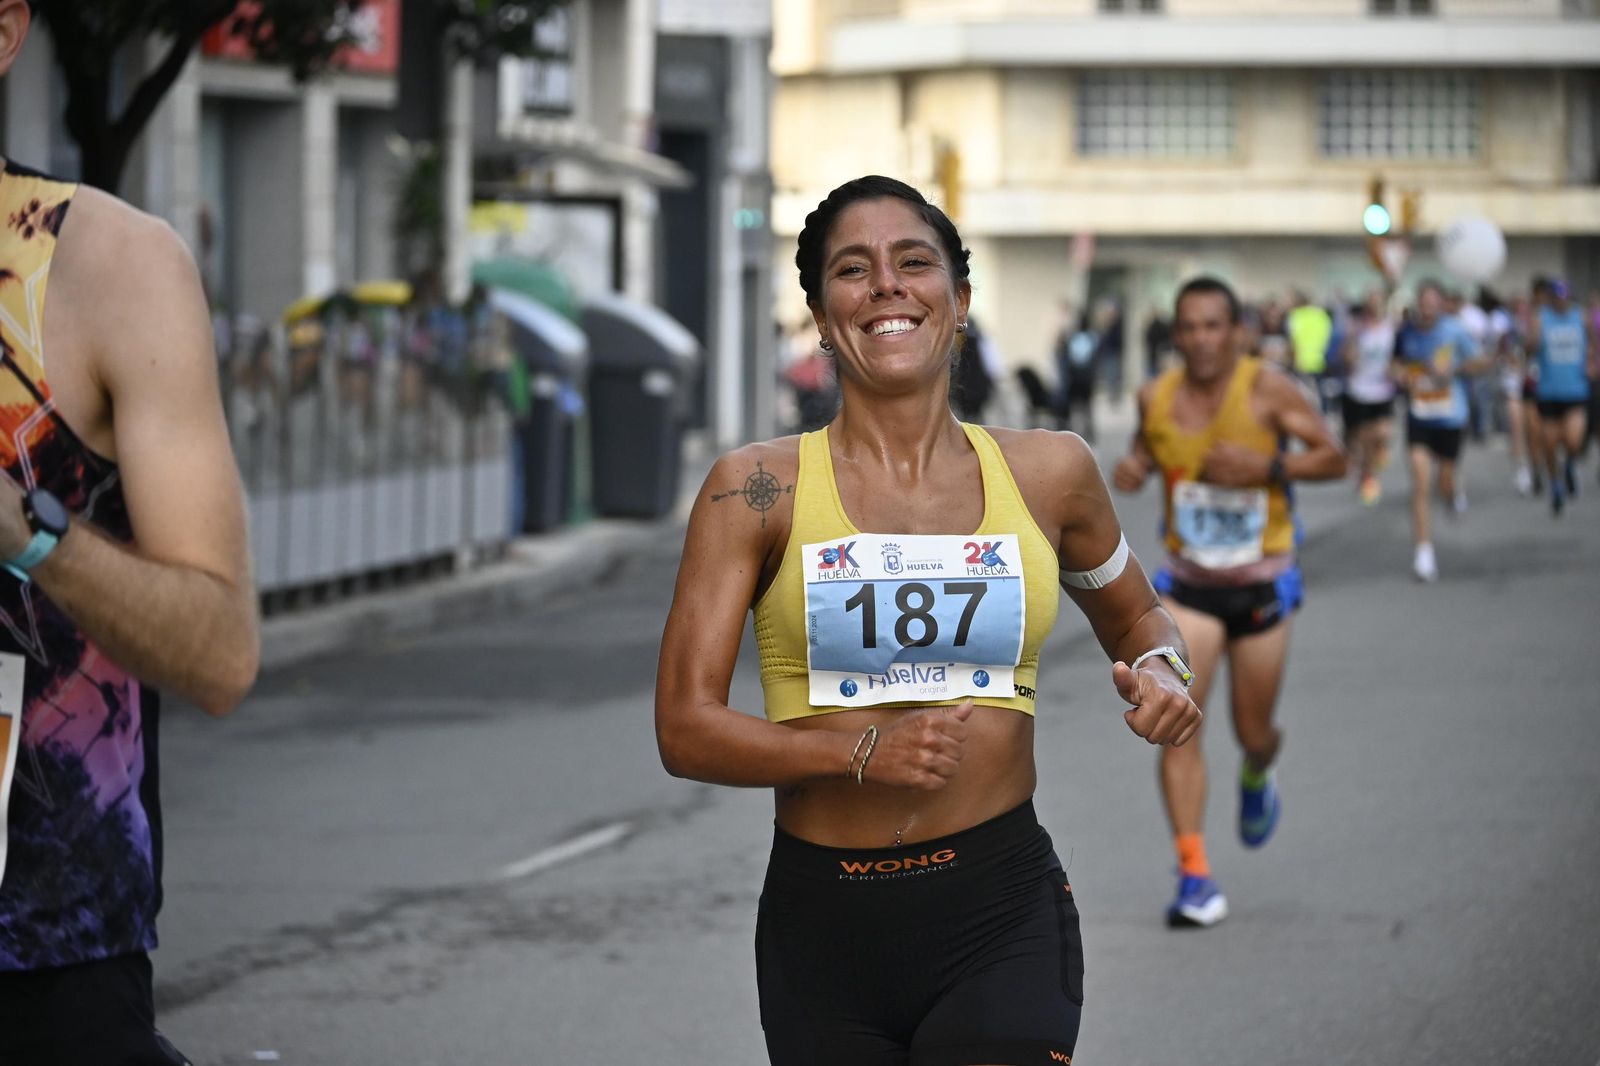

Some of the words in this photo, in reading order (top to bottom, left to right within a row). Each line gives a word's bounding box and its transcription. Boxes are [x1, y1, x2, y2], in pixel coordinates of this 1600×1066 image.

[817, 568, 861, 580] HUELVA
[906, 563, 944, 571] HUELVA
[966, 566, 1010, 576] HUELVA
[845, 582, 988, 649] 187
[867, 663, 946, 689] Huelva
[919, 685, 948, 695] original
[840, 849, 957, 874] WONG
[839, 861, 959, 880] PERFORMANCE
